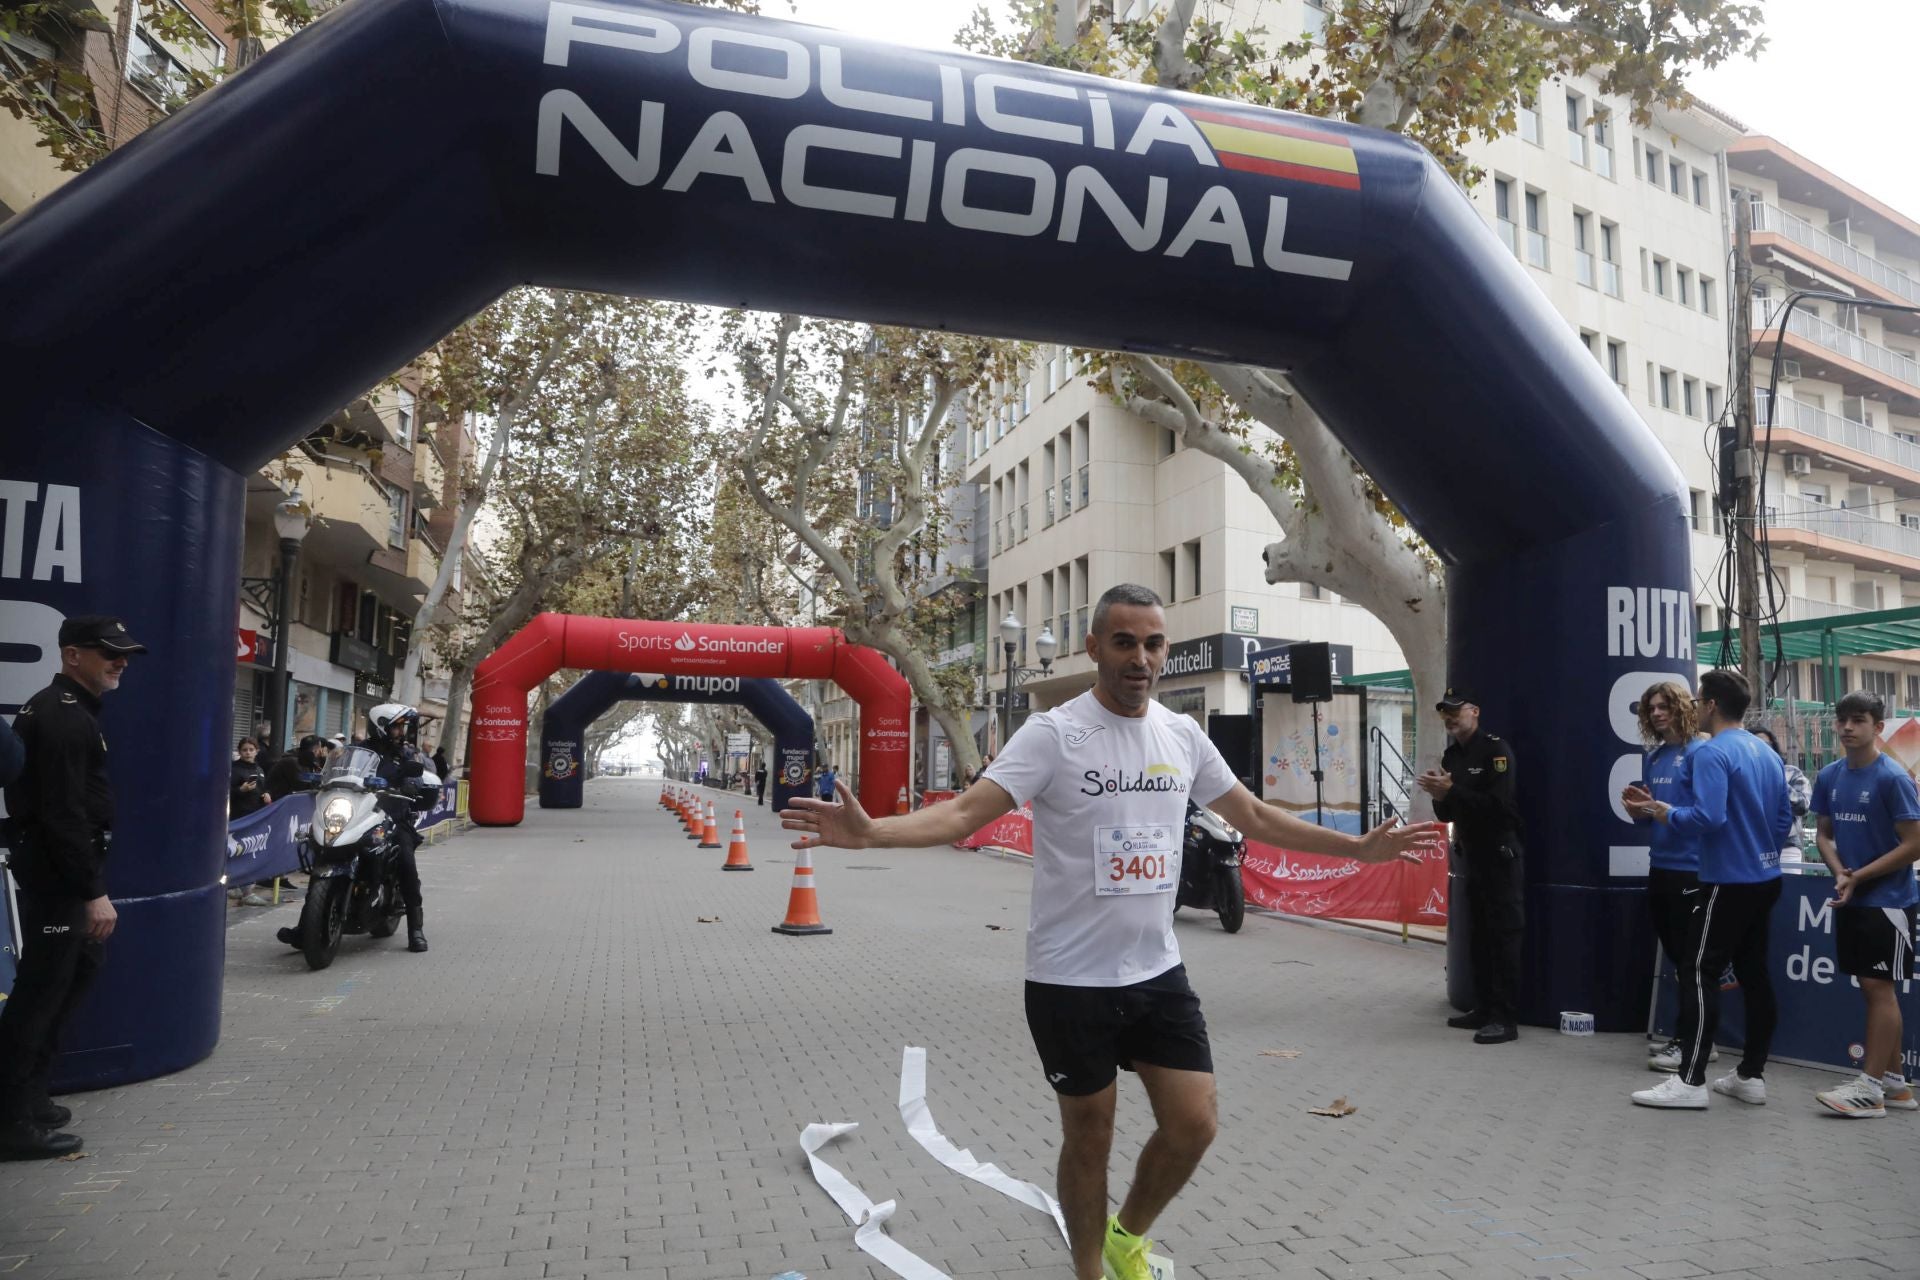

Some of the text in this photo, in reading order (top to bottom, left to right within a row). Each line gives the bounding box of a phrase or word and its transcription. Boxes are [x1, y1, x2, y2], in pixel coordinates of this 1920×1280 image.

[535, 88, 1355, 282] NACIONAL
[0, 479, 82, 583] TA
[1607, 586, 1692, 660] RUTA
[618, 631, 784, 654] Sports Santander
[675, 675, 740, 696] mupol
[483, 718, 522, 726] Santander
[486, 704, 512, 717] Sports
[1109, 855, 1165, 881] 3401
[43, 926, 70, 934] CNP
[1786, 945, 1835, 985] de
